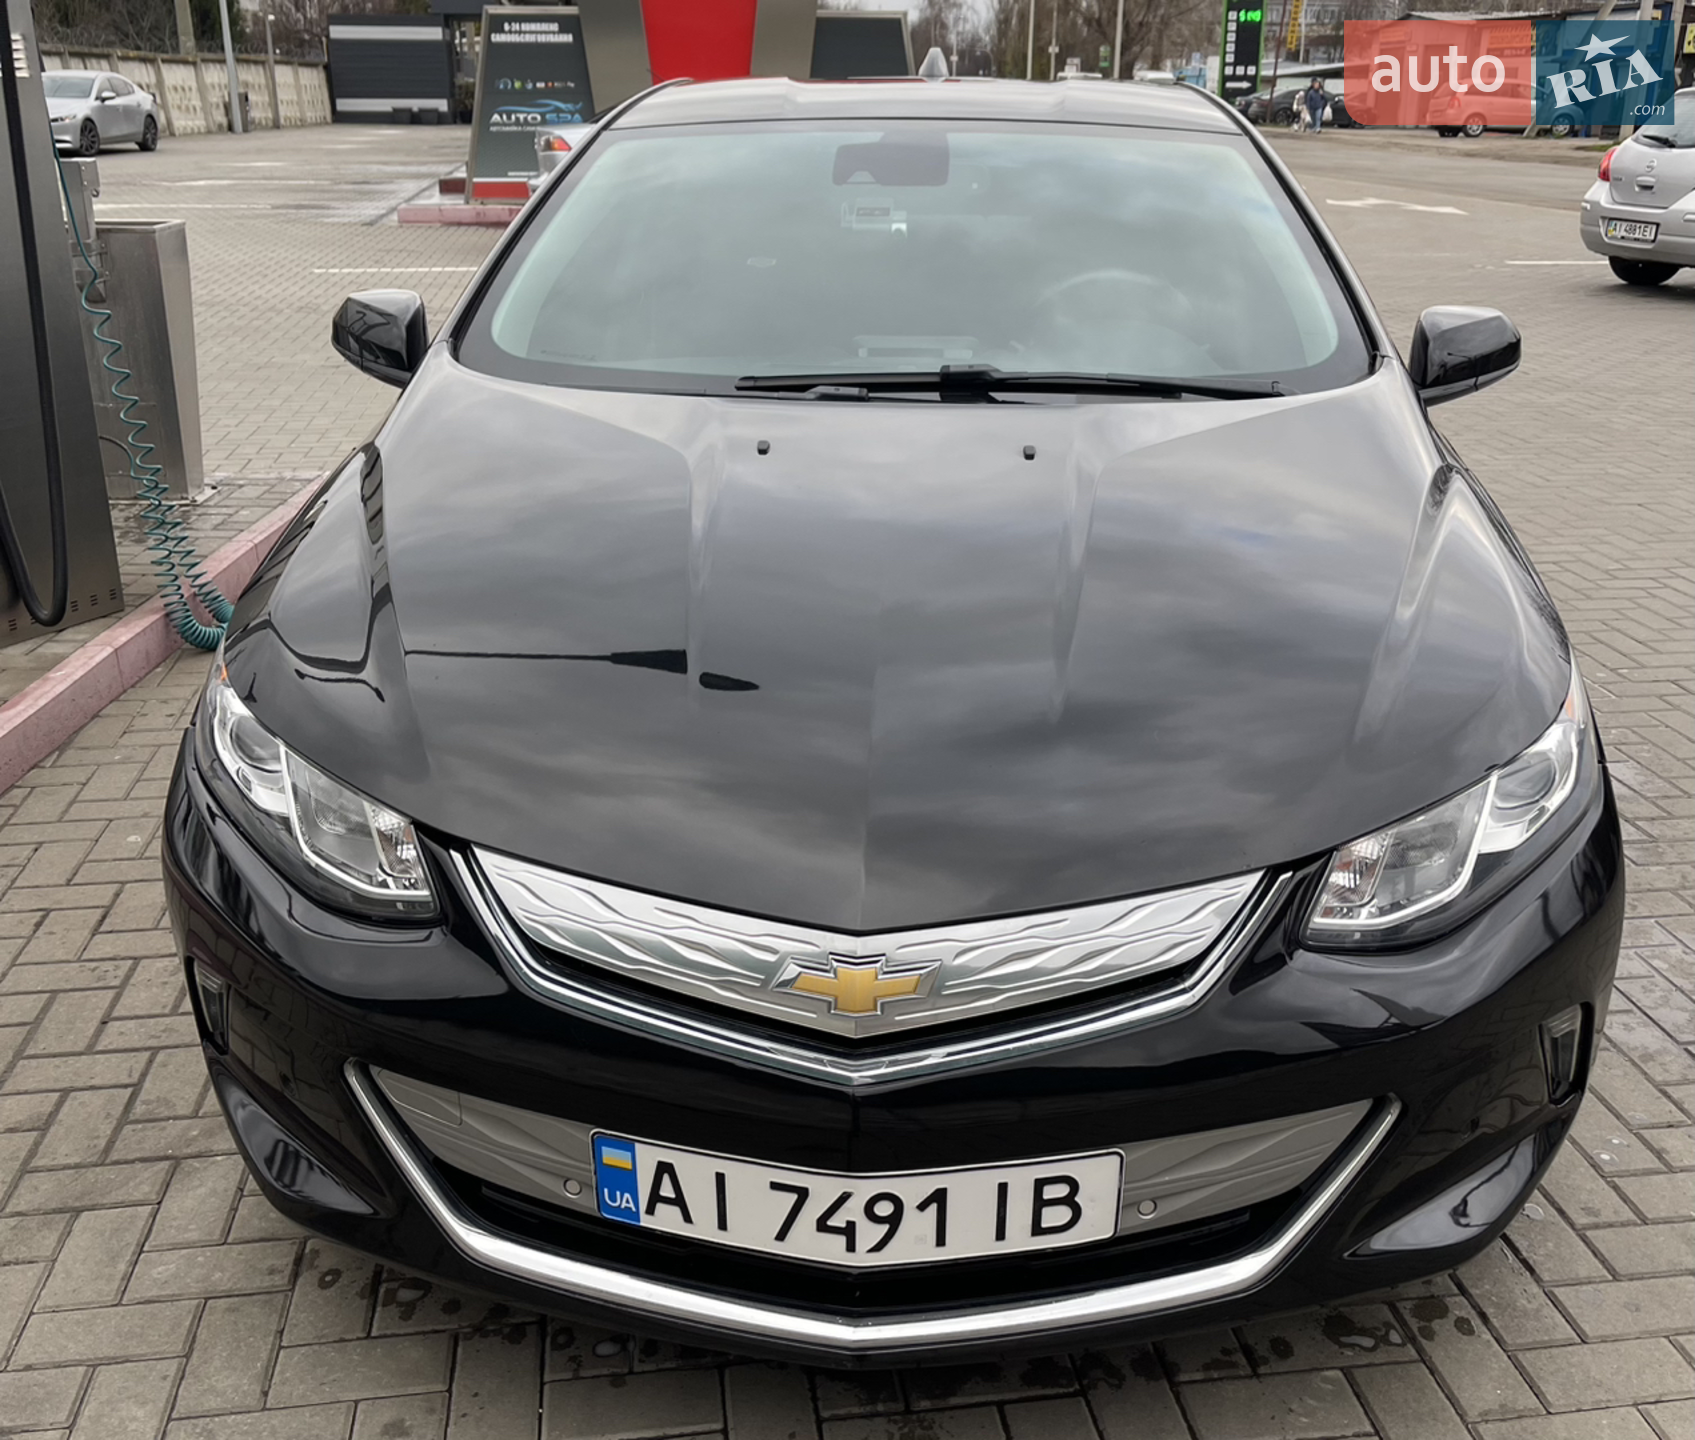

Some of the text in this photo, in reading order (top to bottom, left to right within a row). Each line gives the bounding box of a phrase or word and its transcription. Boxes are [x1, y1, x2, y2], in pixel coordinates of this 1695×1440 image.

[489, 113, 583, 125] AUTO SPA
[603, 1187, 636, 1213] UA
[645, 1160, 1082, 1253] AI 7491 IB
